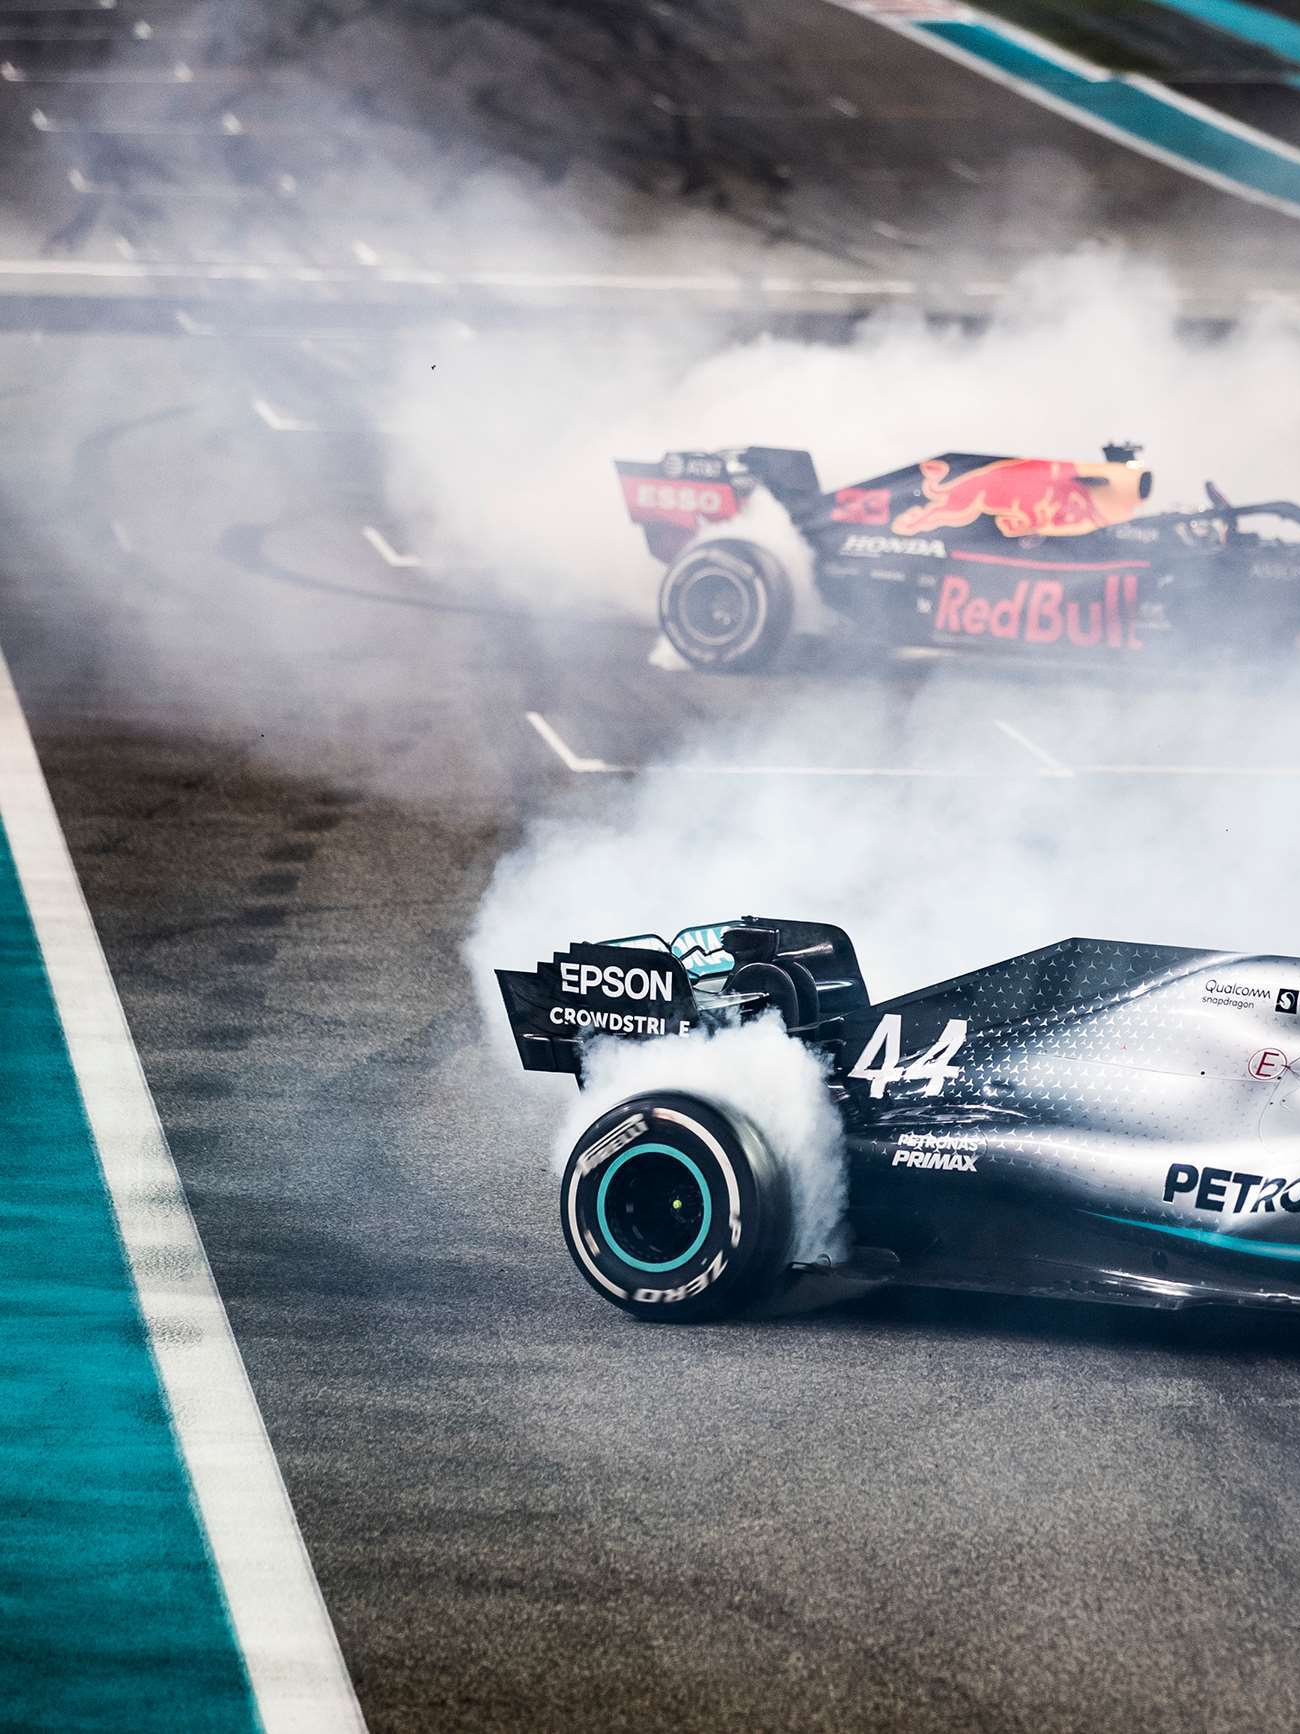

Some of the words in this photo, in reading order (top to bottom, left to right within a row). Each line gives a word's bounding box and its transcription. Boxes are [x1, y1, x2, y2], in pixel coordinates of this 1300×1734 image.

[839, 535, 946, 559] HONDA
[560, 962, 673, 1002] EPSON
[1205, 979, 1271, 999] Qualcomm
[1201, 996, 1254, 1010] snapdragon
[550, 1006, 690, 1037] CROWDSTRIE
[848, 1013, 968, 1099] 44
[1255, 1051, 1279, 1077] E
[898, 1133, 979, 1151] PETRONAS
[892, 1150, 977, 1172] PRIMAX
